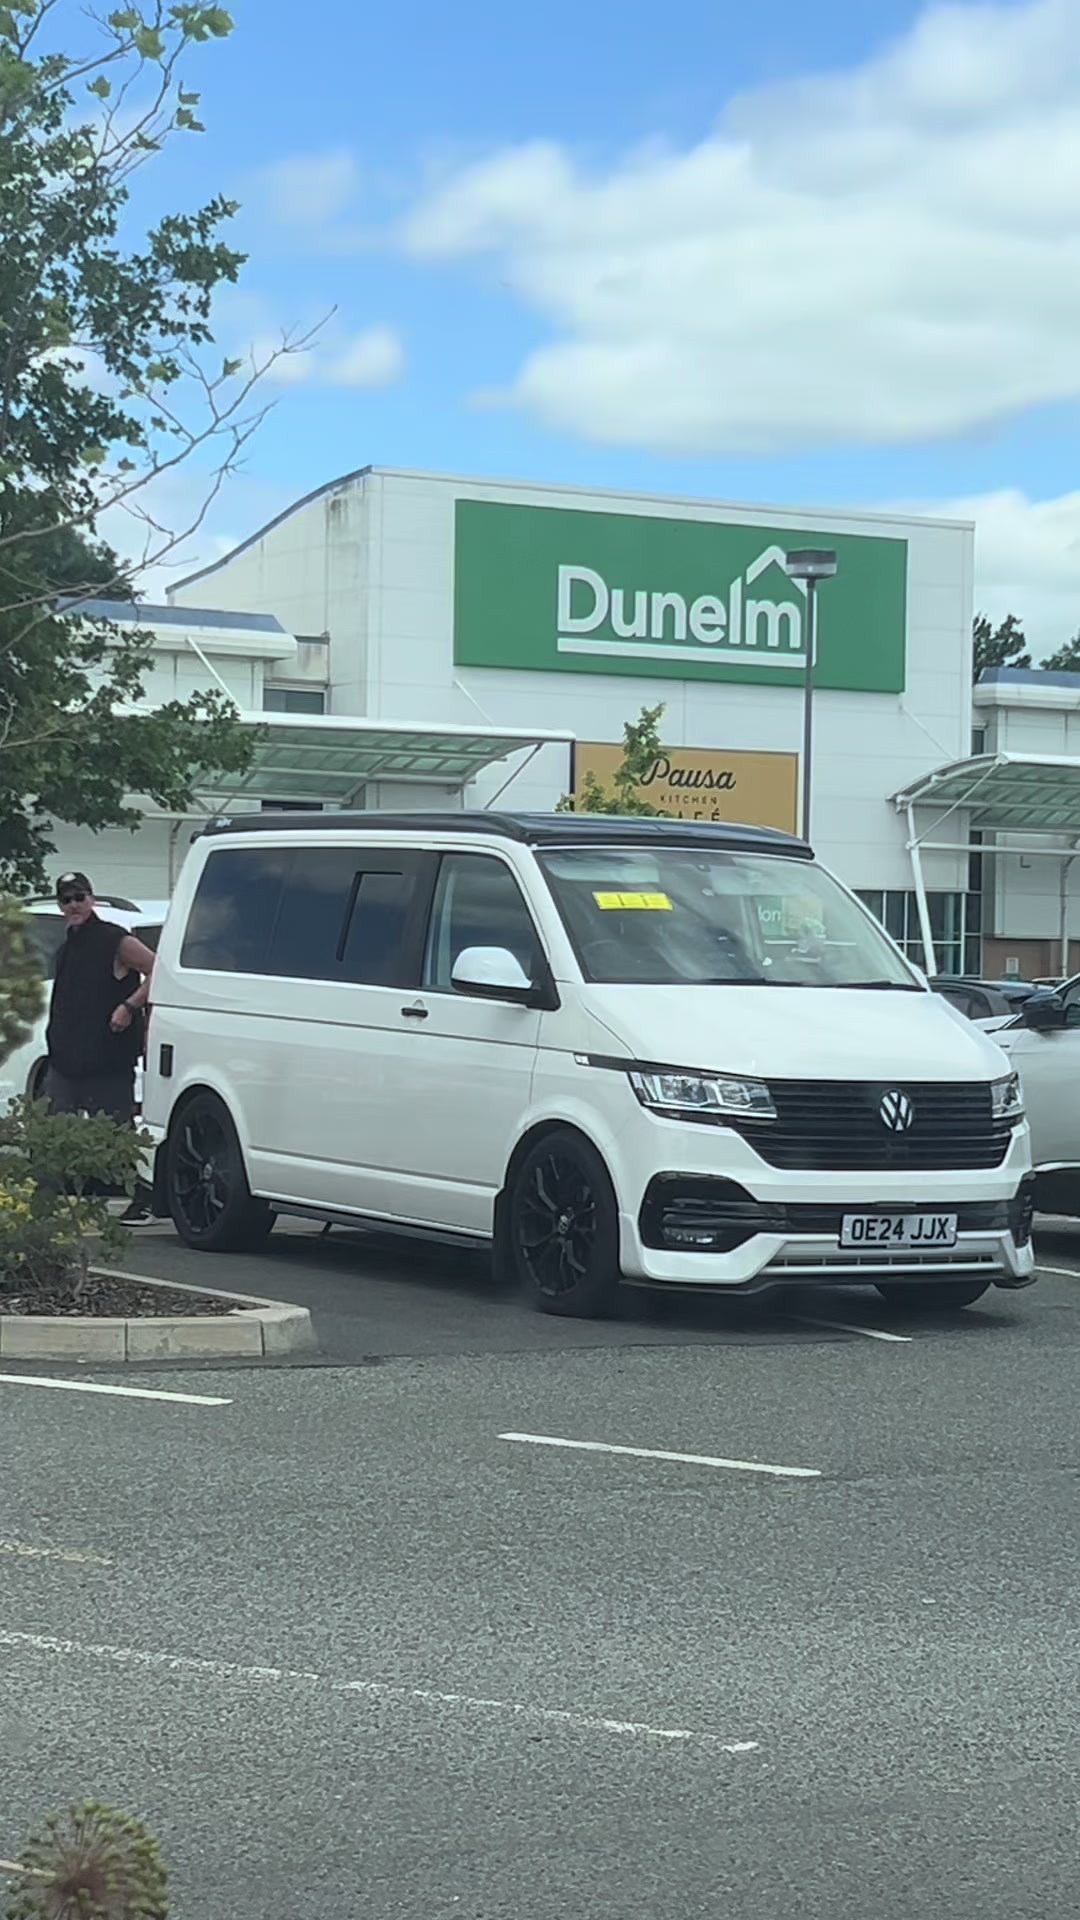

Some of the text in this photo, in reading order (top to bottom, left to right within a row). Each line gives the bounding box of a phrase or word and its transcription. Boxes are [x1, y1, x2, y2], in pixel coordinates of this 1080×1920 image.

[557, 564, 801, 649] Dunelm
[640, 757, 737, 790] Pausa
[660, 794, 718, 805] KITCHEN
[880, 1090, 913, 1132] VW
[851, 1217, 950, 1241] OE24 JJX
